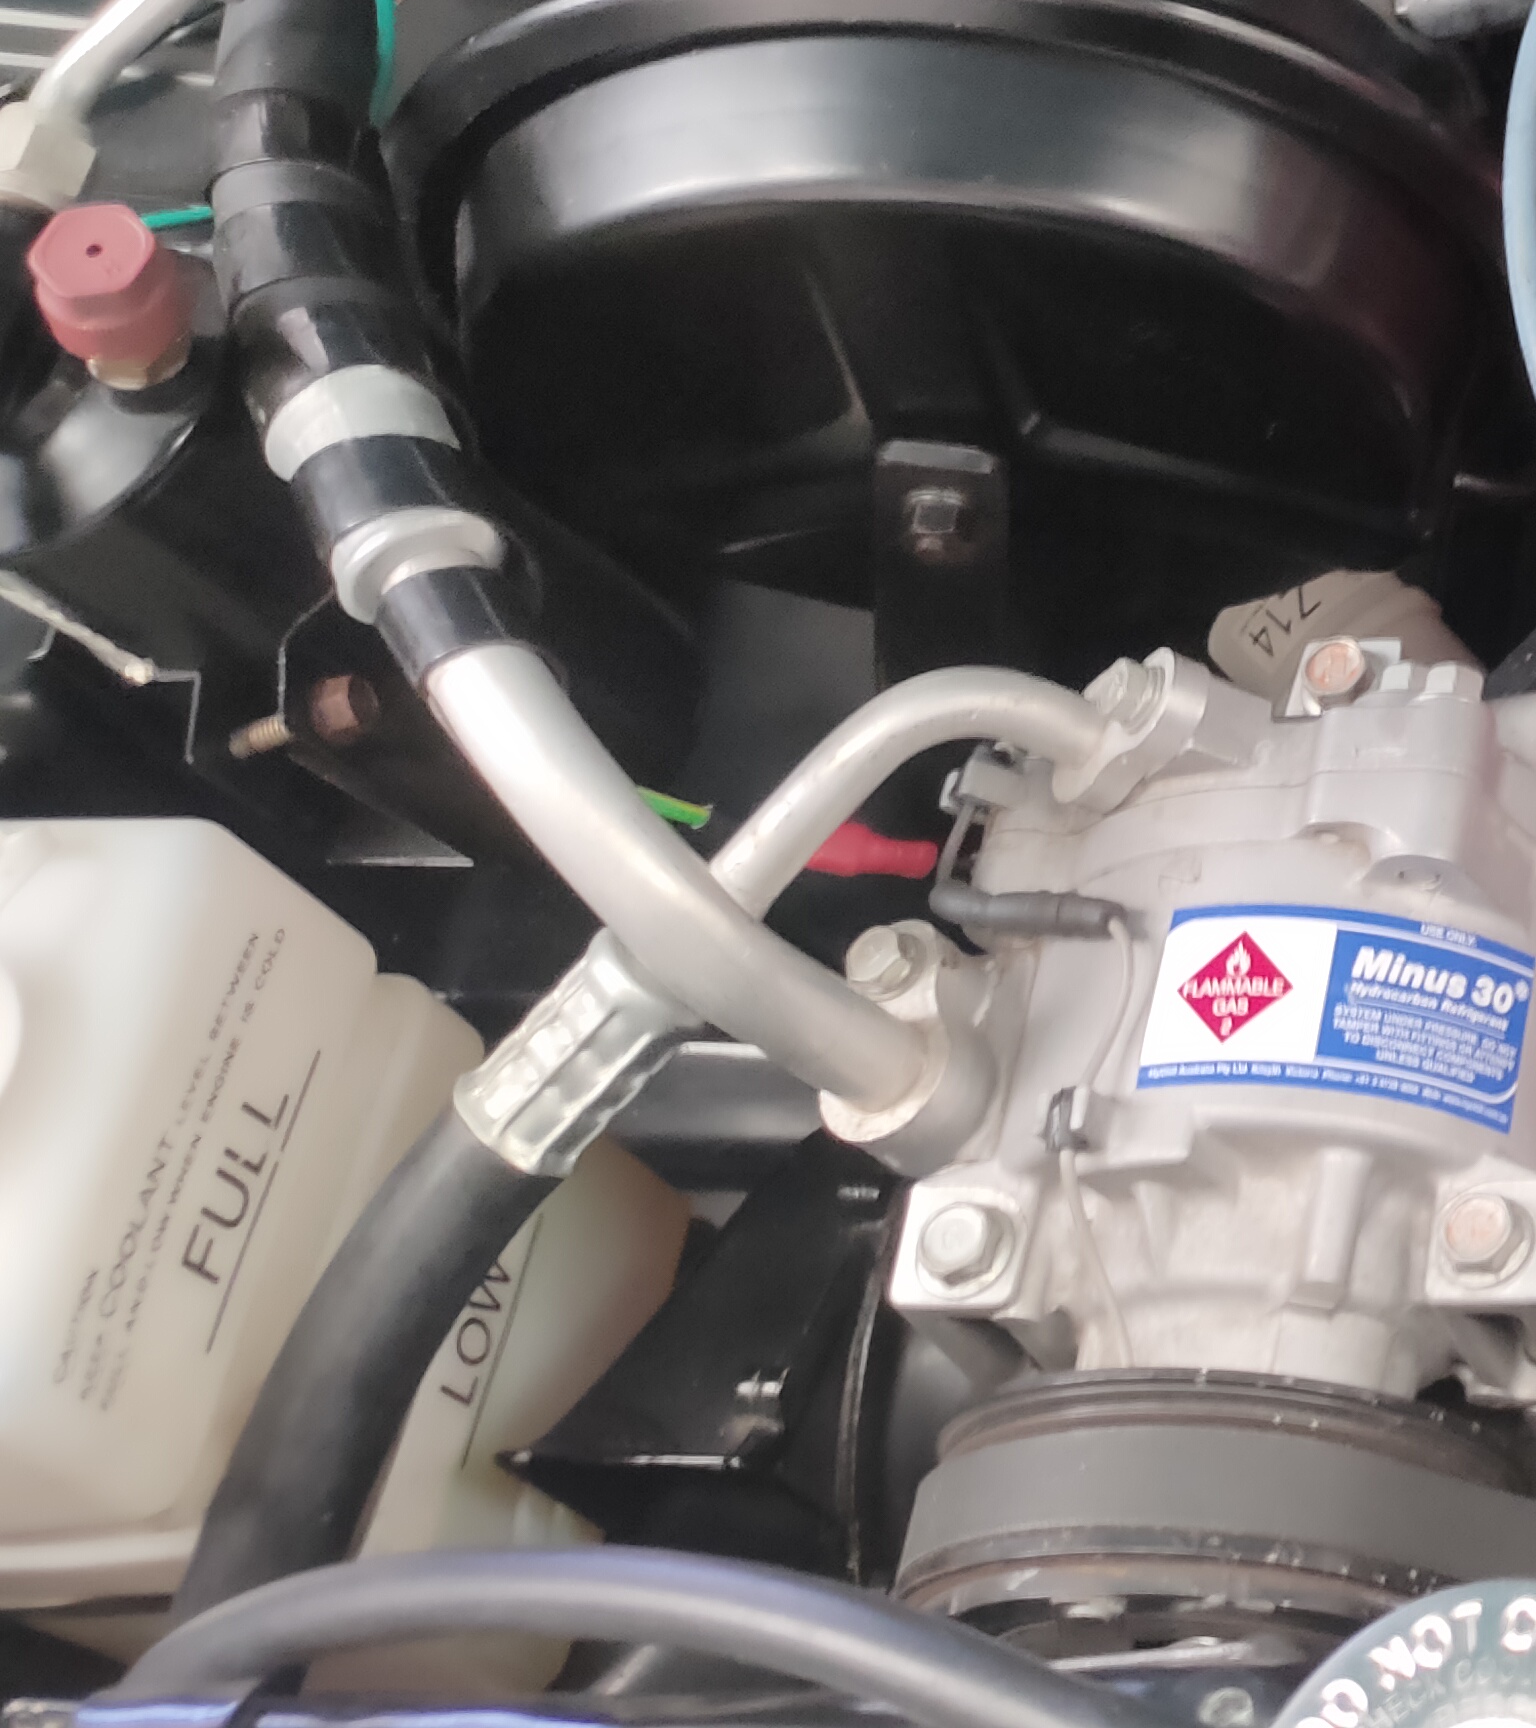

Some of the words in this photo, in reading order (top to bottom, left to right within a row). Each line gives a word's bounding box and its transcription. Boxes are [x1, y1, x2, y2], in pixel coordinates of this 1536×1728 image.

[201, 1037, 242, 1122] ENGINE
[254, 927, 287, 992] COLD
[1182, 974, 1285, 999] FLAMMABLE
[1212, 996, 1249, 1016] GAS
[1351, 945, 1468, 999] Minus
[101, 1130, 174, 1318] COOLANT
[208, 931, 261, 1040] BETWEEN
[181, 1094, 290, 1285] FULL
[440, 1260, 513, 1407] LOW
[1368, 1599, 1484, 1691] NOT
